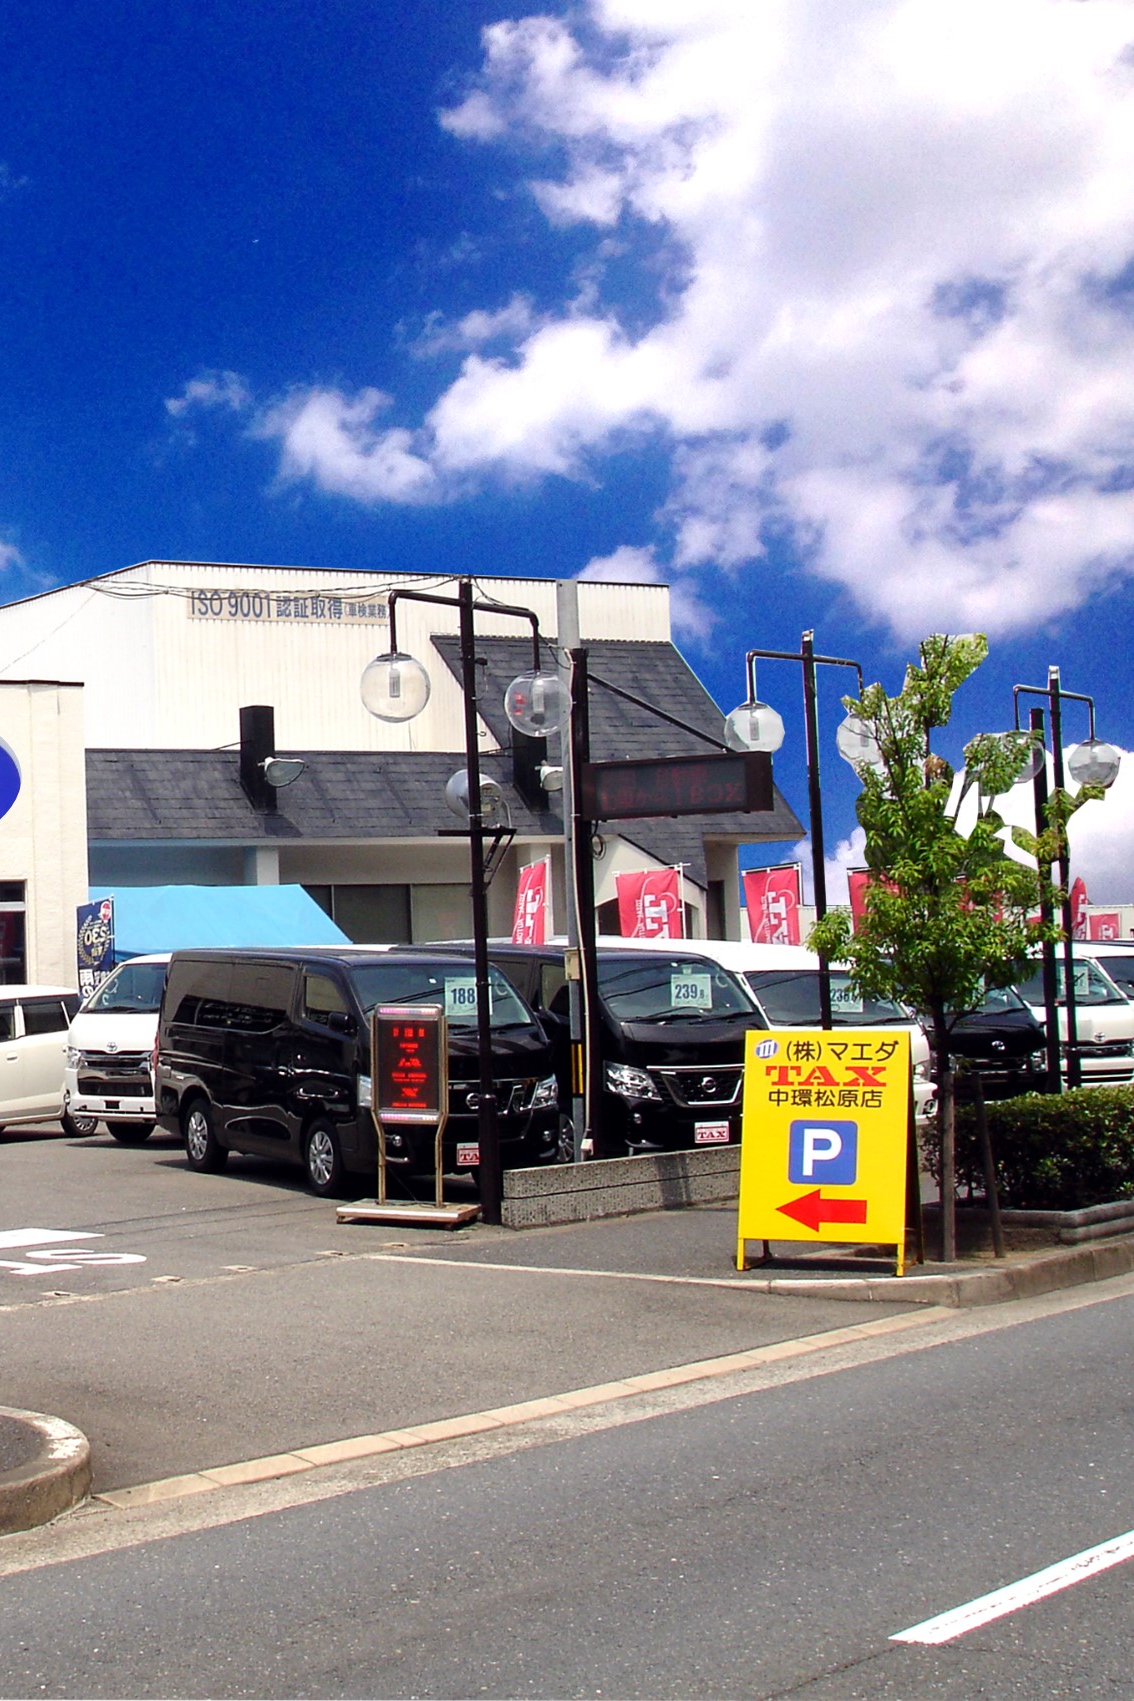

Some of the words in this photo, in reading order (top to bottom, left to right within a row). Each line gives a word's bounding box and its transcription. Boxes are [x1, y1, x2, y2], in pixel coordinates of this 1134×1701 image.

[190, 590, 223, 616] ISO
[228, 591, 271, 618] 9001
[786, 1040, 899, 1062] (株)マエダ
[765, 1065, 887, 1087] TAX
[768, 1089, 883, 1108] 中環松原店
[698, 1130, 726, 1139] TAX
[802, 1128, 842, 1176] P
